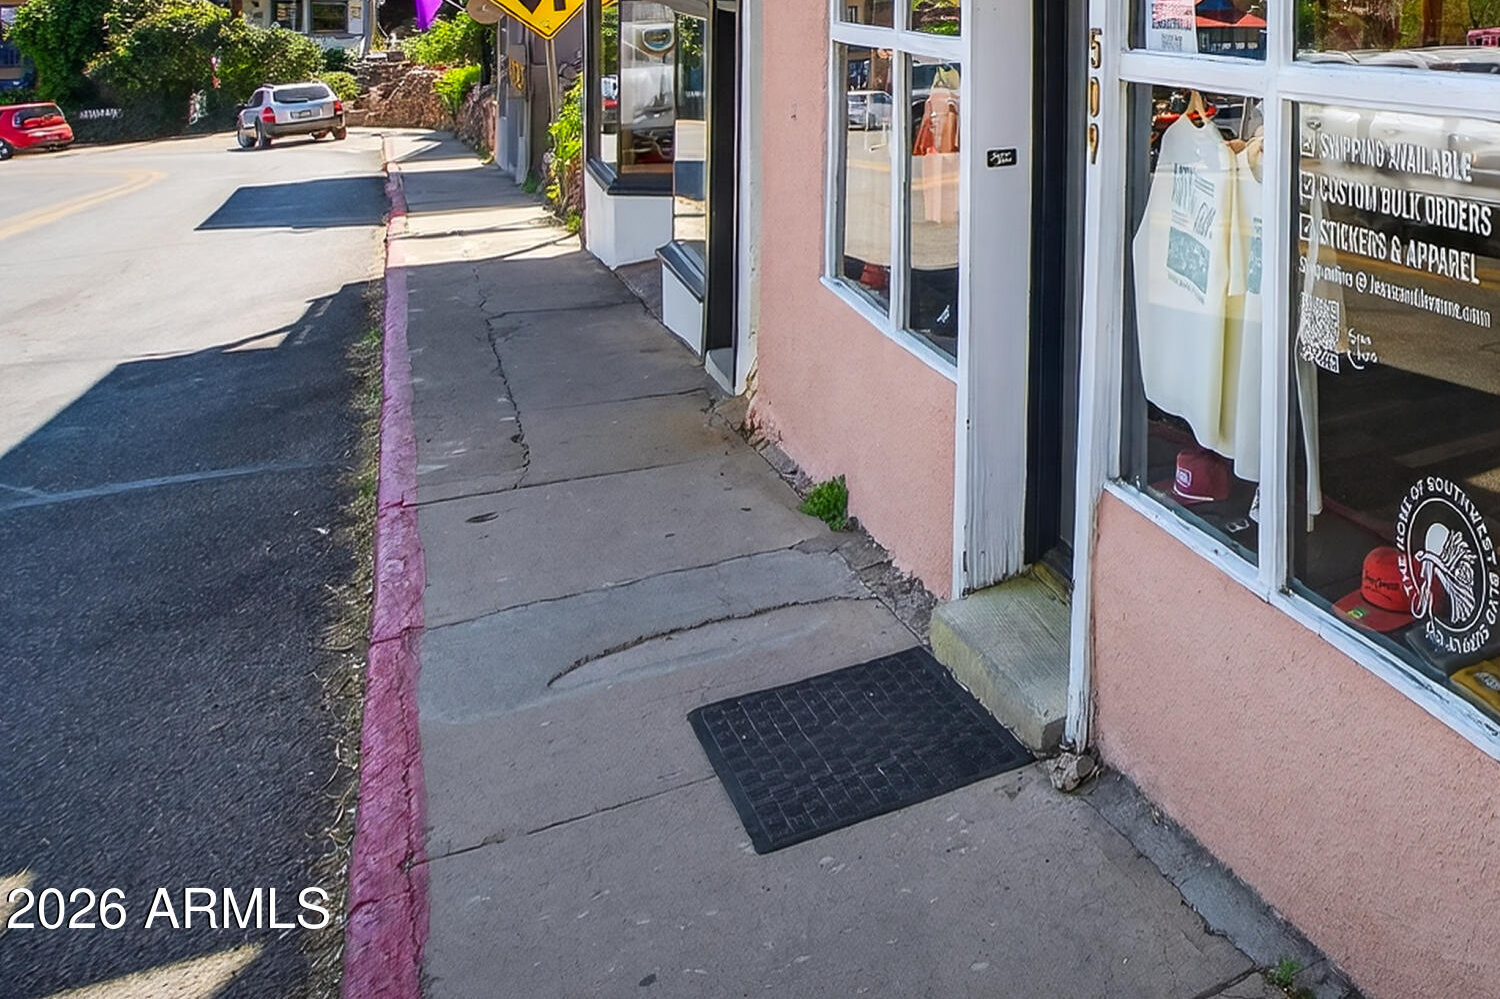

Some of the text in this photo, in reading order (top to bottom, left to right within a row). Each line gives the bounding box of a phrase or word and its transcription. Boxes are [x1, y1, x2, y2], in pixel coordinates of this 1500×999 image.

[1319, 132, 1473, 183] SHIPPING AVAILABLE
[1319, 175, 1492, 237] CUSTOM BULK ORDERS
[1319, 219, 1480, 285] STICKERS & APPAREL
[1426, 476, 1497, 566] SOUTHWEST
